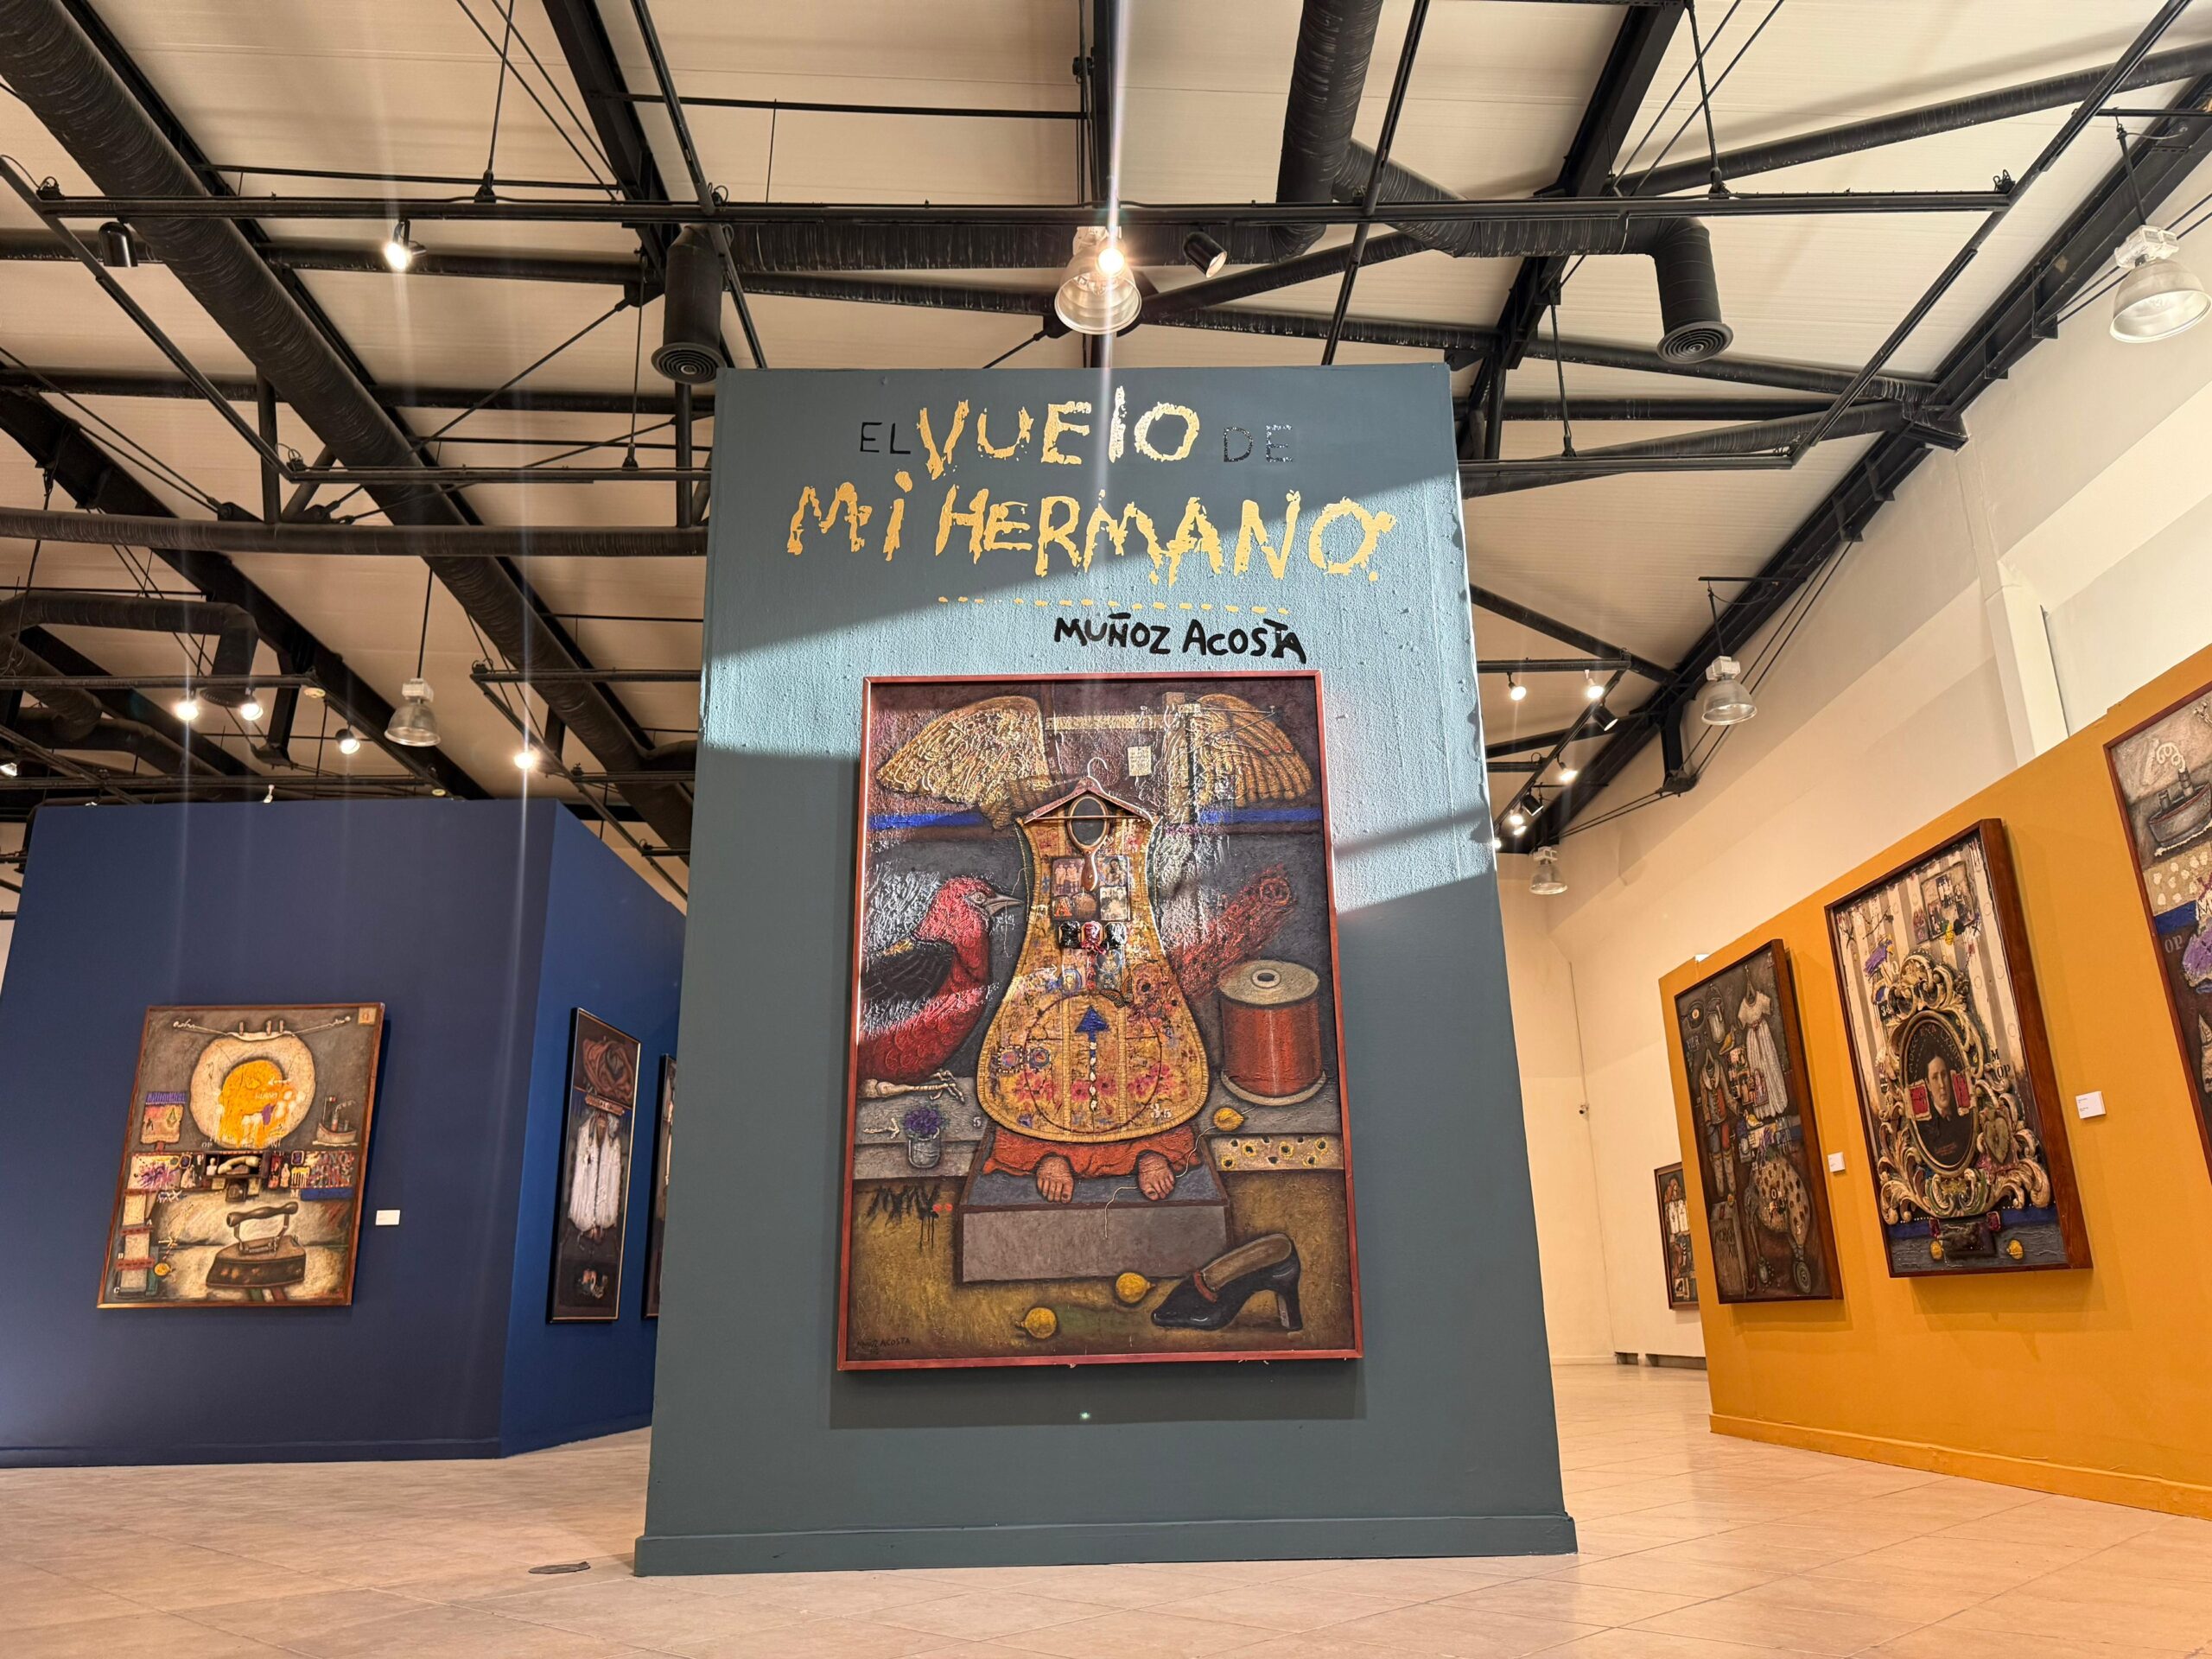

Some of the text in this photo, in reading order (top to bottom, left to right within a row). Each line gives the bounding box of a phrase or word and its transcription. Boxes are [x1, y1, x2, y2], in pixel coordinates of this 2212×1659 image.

[859, 421, 912, 455] EL
[1223, 424, 1294, 463] DE
[935, 485, 1397, 585] HERMANO
[1053, 612, 1172, 656] MUÑOZ
